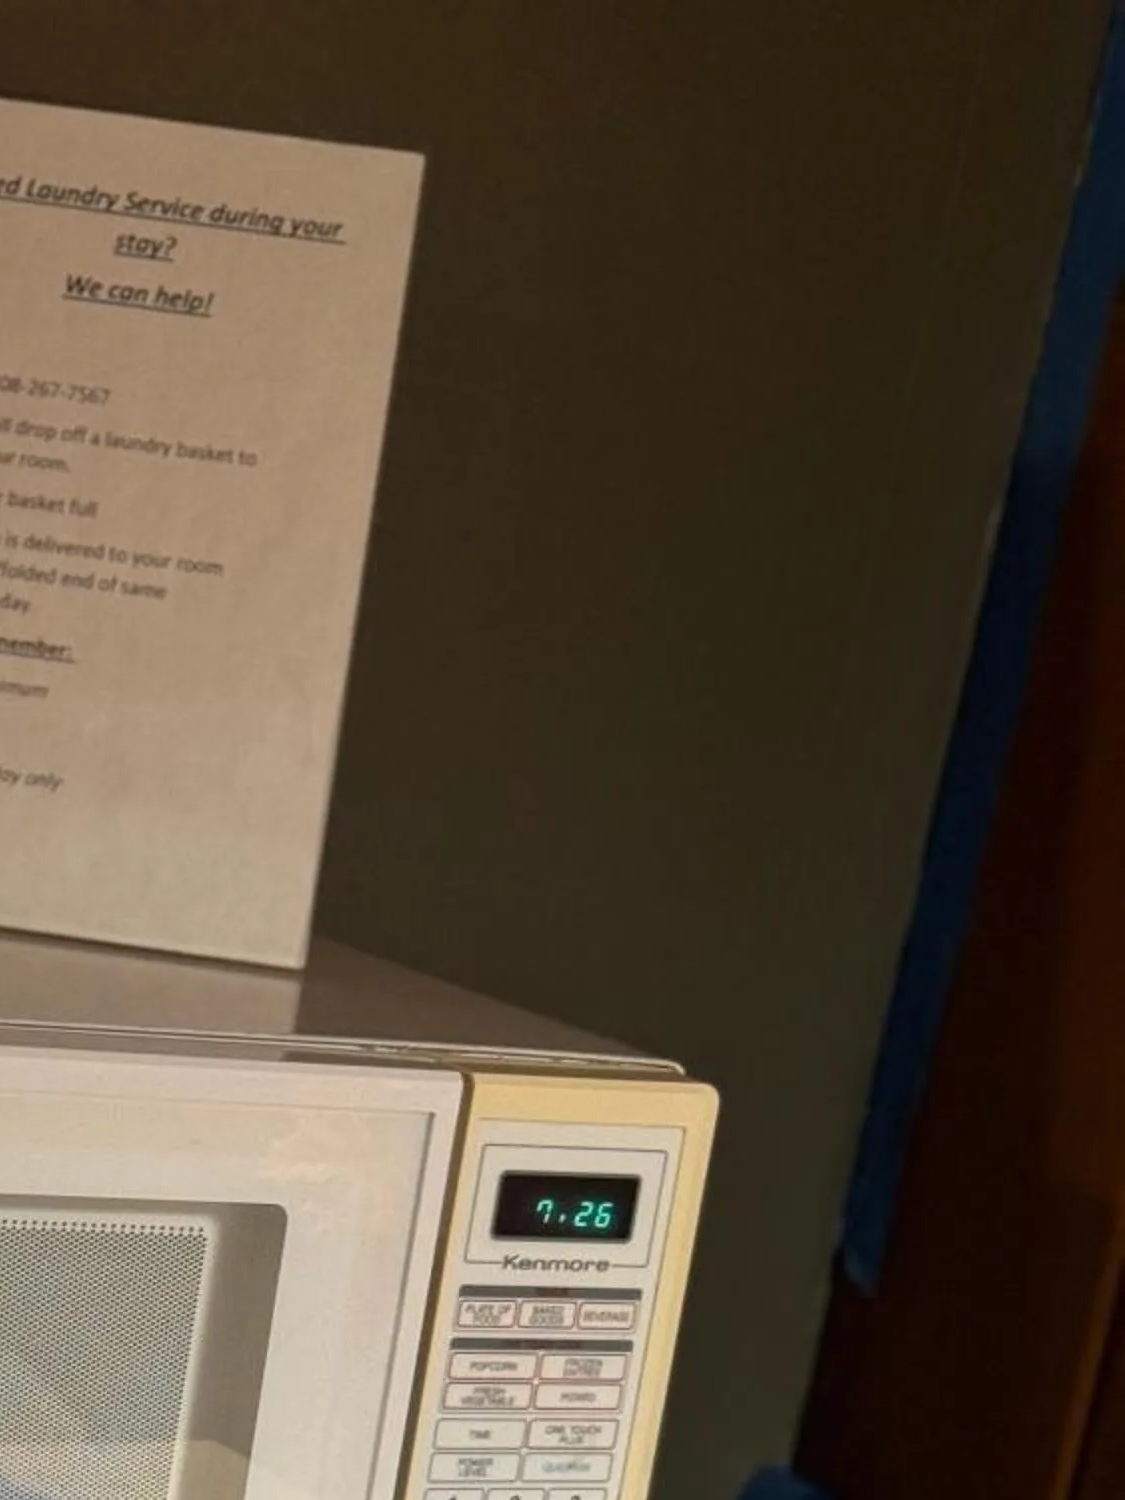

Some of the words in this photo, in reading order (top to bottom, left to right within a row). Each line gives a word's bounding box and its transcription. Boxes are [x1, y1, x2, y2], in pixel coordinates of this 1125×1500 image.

[25, 178, 119, 214] Laundry
[124, 189, 205, 222] Service
[208, 203, 284, 237] during
[286, 217, 345, 243] your
[114, 231, 178, 261] stay?
[63, 272, 102, 300] We
[106, 282, 150, 303] can
[153, 285, 216, 317] help!
[14, 420, 57, 441] drop
[61, 426, 91, 445] off
[90, 433, 101, 446] a
[105, 432, 173, 459] laundry
[176, 441, 235, 466] basket
[238, 449, 259, 468] to
[7, 488, 65, 515] basket
[69, 499, 100, 519] full
[5, 530, 19, 549] is
[22, 533, 106, 562] delivered
[108, 546, 129, 565] to
[131, 551, 172, 573] your
[176, 559, 225, 577] room
[61, 571, 95, 592] end
[97, 577, 119, 595] of
[120, 582, 168, 600] same
[0, 593, 32, 615] day
[24, 771, 65, 794] only
[502, 1253, 611, 1274] Kenmore
